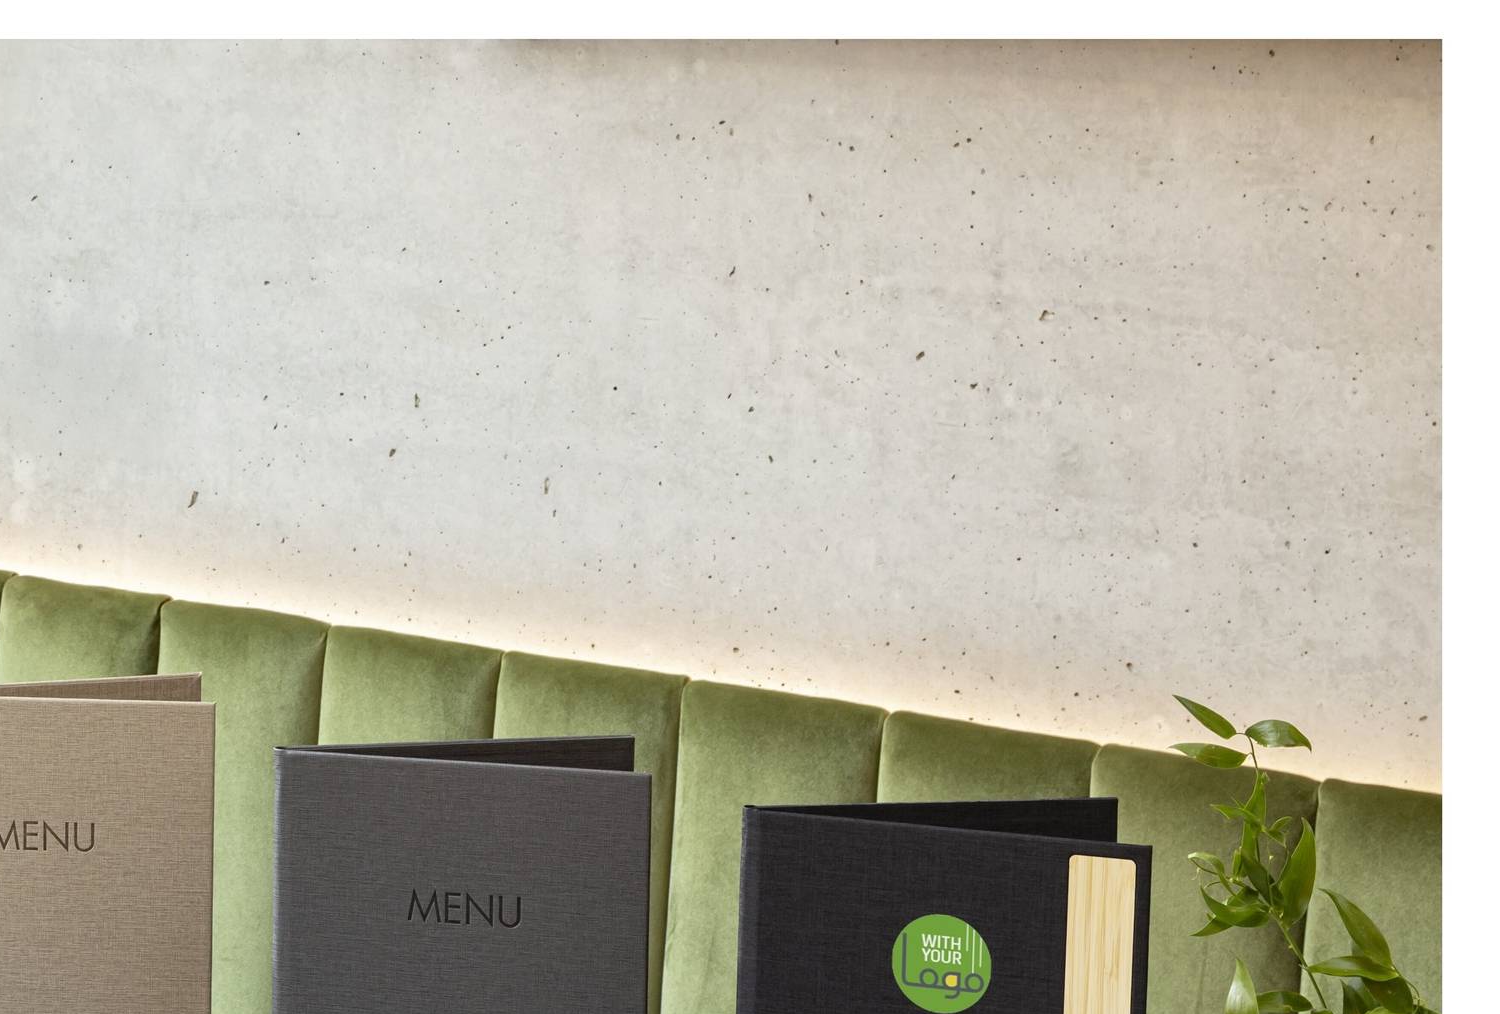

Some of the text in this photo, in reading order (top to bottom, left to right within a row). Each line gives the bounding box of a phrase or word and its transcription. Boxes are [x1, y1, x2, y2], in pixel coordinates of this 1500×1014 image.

[406, 888, 523, 930] MENU
[921, 933, 961, 951] WITH
[921, 948, 962, 965] YOUR
